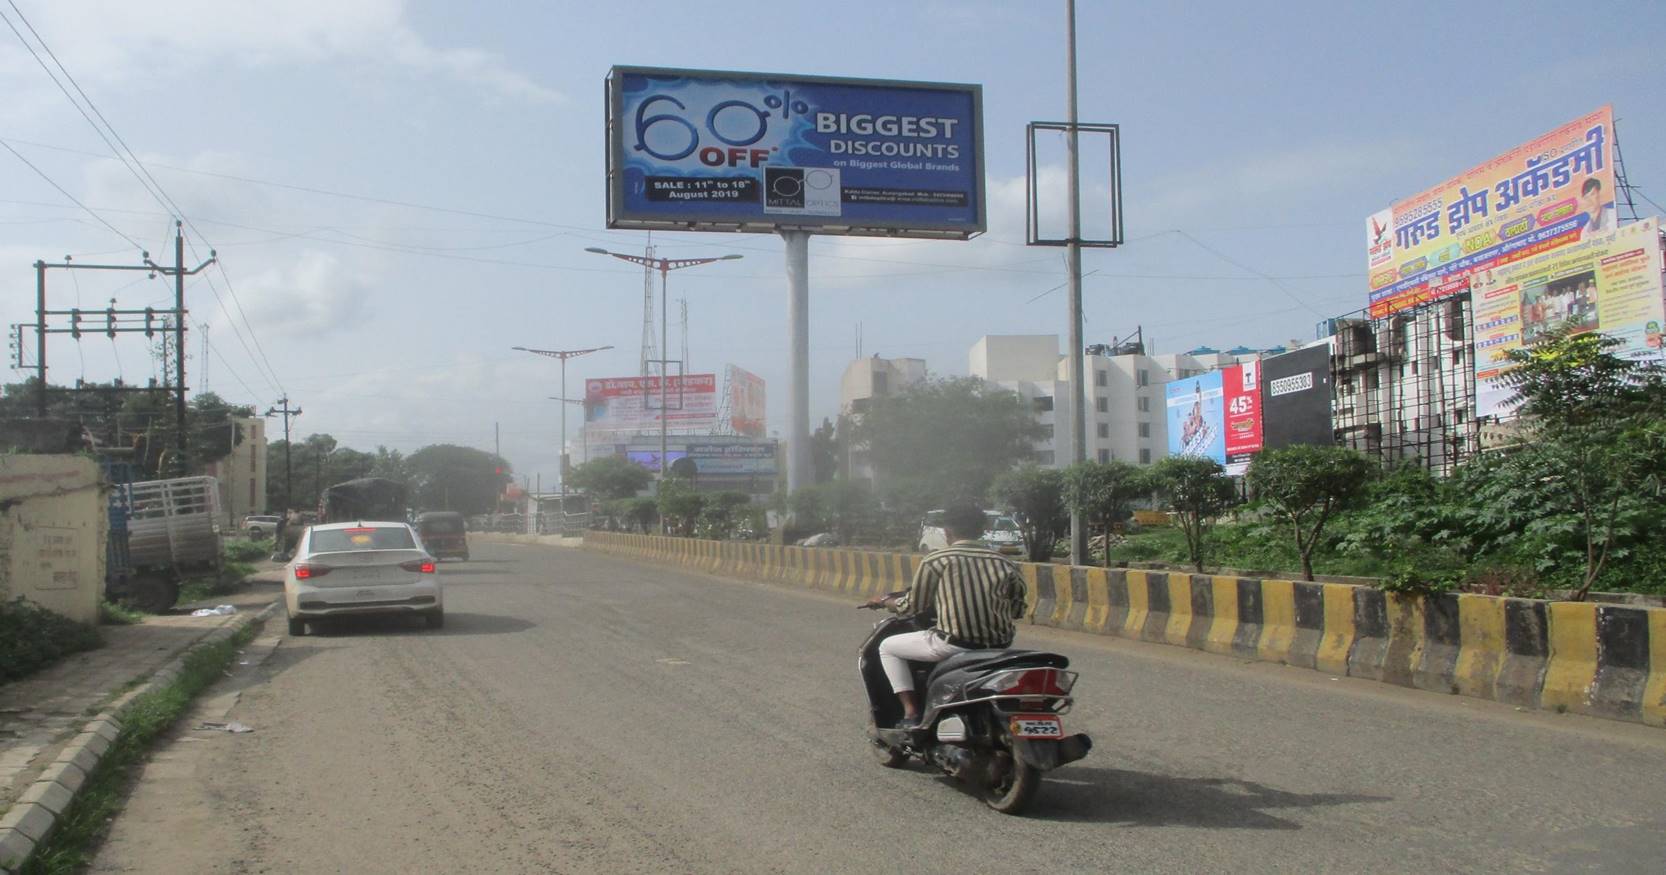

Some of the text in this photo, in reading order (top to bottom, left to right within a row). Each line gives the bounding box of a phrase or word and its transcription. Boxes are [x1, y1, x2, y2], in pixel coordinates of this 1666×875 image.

[816, 112, 958, 138] BIGGEST
[830, 140, 960, 158] DISCOUNTS
[849, 160, 888, 170] Biggest
[889, 161, 922, 170] Global
[925, 163, 960, 172] Brands
[654, 181, 684, 189] SALE
[717, 181, 728, 189] to
[668, 190, 739, 199] August 2019
[1395, 211, 1440, 249] गरुड
[1447, 187, 1489, 235] झेप
